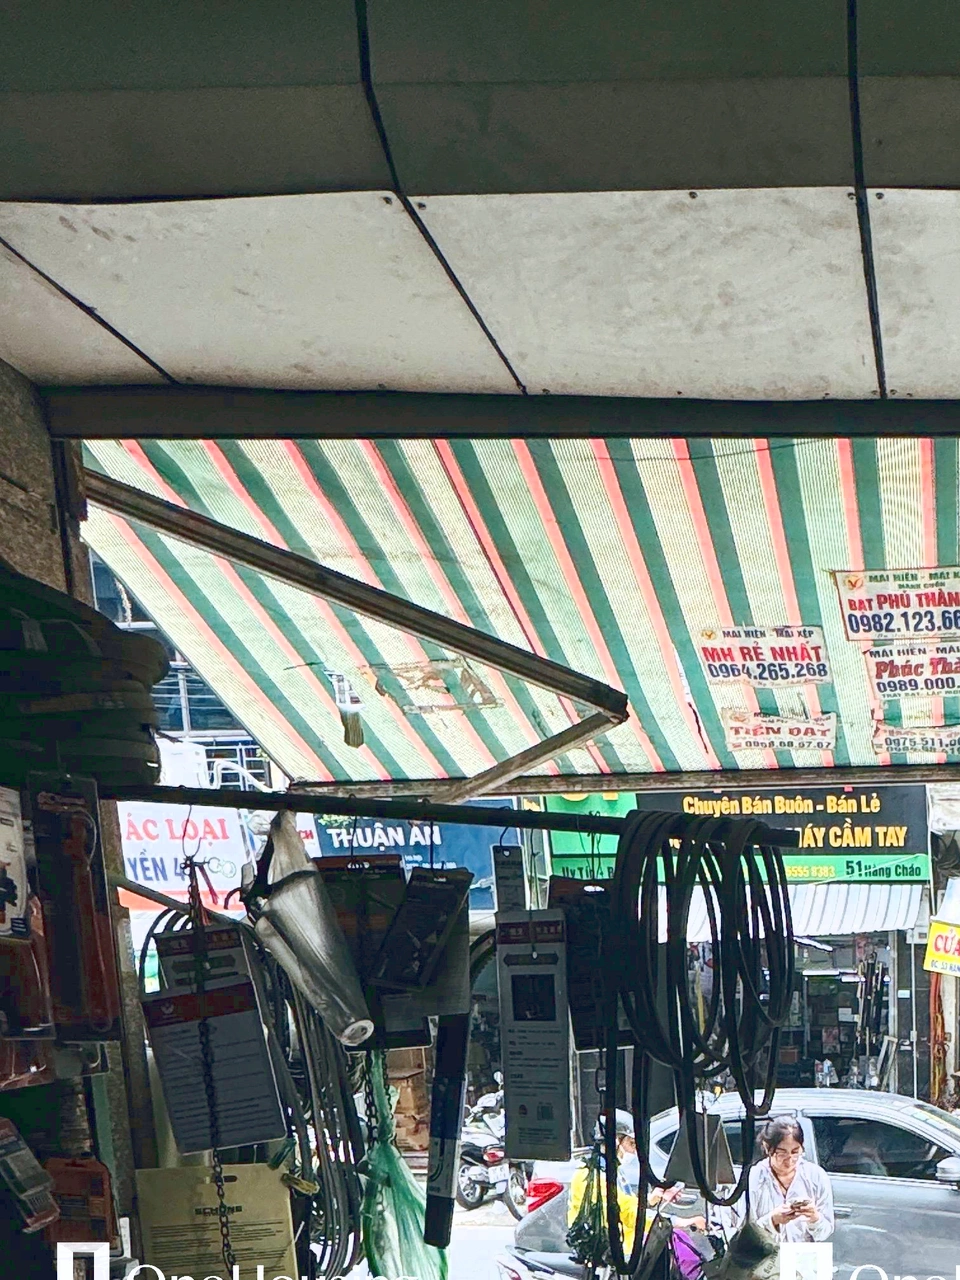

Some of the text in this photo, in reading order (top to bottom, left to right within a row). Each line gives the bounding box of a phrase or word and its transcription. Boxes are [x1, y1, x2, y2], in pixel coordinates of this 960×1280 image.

[702, 646, 736, 662] MH
[770, 641, 822, 662] NHẤT
[708, 662, 828, 681] 0964.265.268
[876, 660, 924, 680] Phúc
[683, 796, 740, 818] Chuyên
[742, 795, 769, 815] Bán
[774, 795, 814, 814] Buôn
[826, 794, 854, 814] Bán
[861, 792, 881, 814] Lẻ
[165, 819, 230, 847] LOẠI
[326, 822, 406, 852] THUẬN
[829, 818, 872, 848] CẦM
[874, 826, 908, 847] TAY
[894, 861, 922, 878] Cháo
